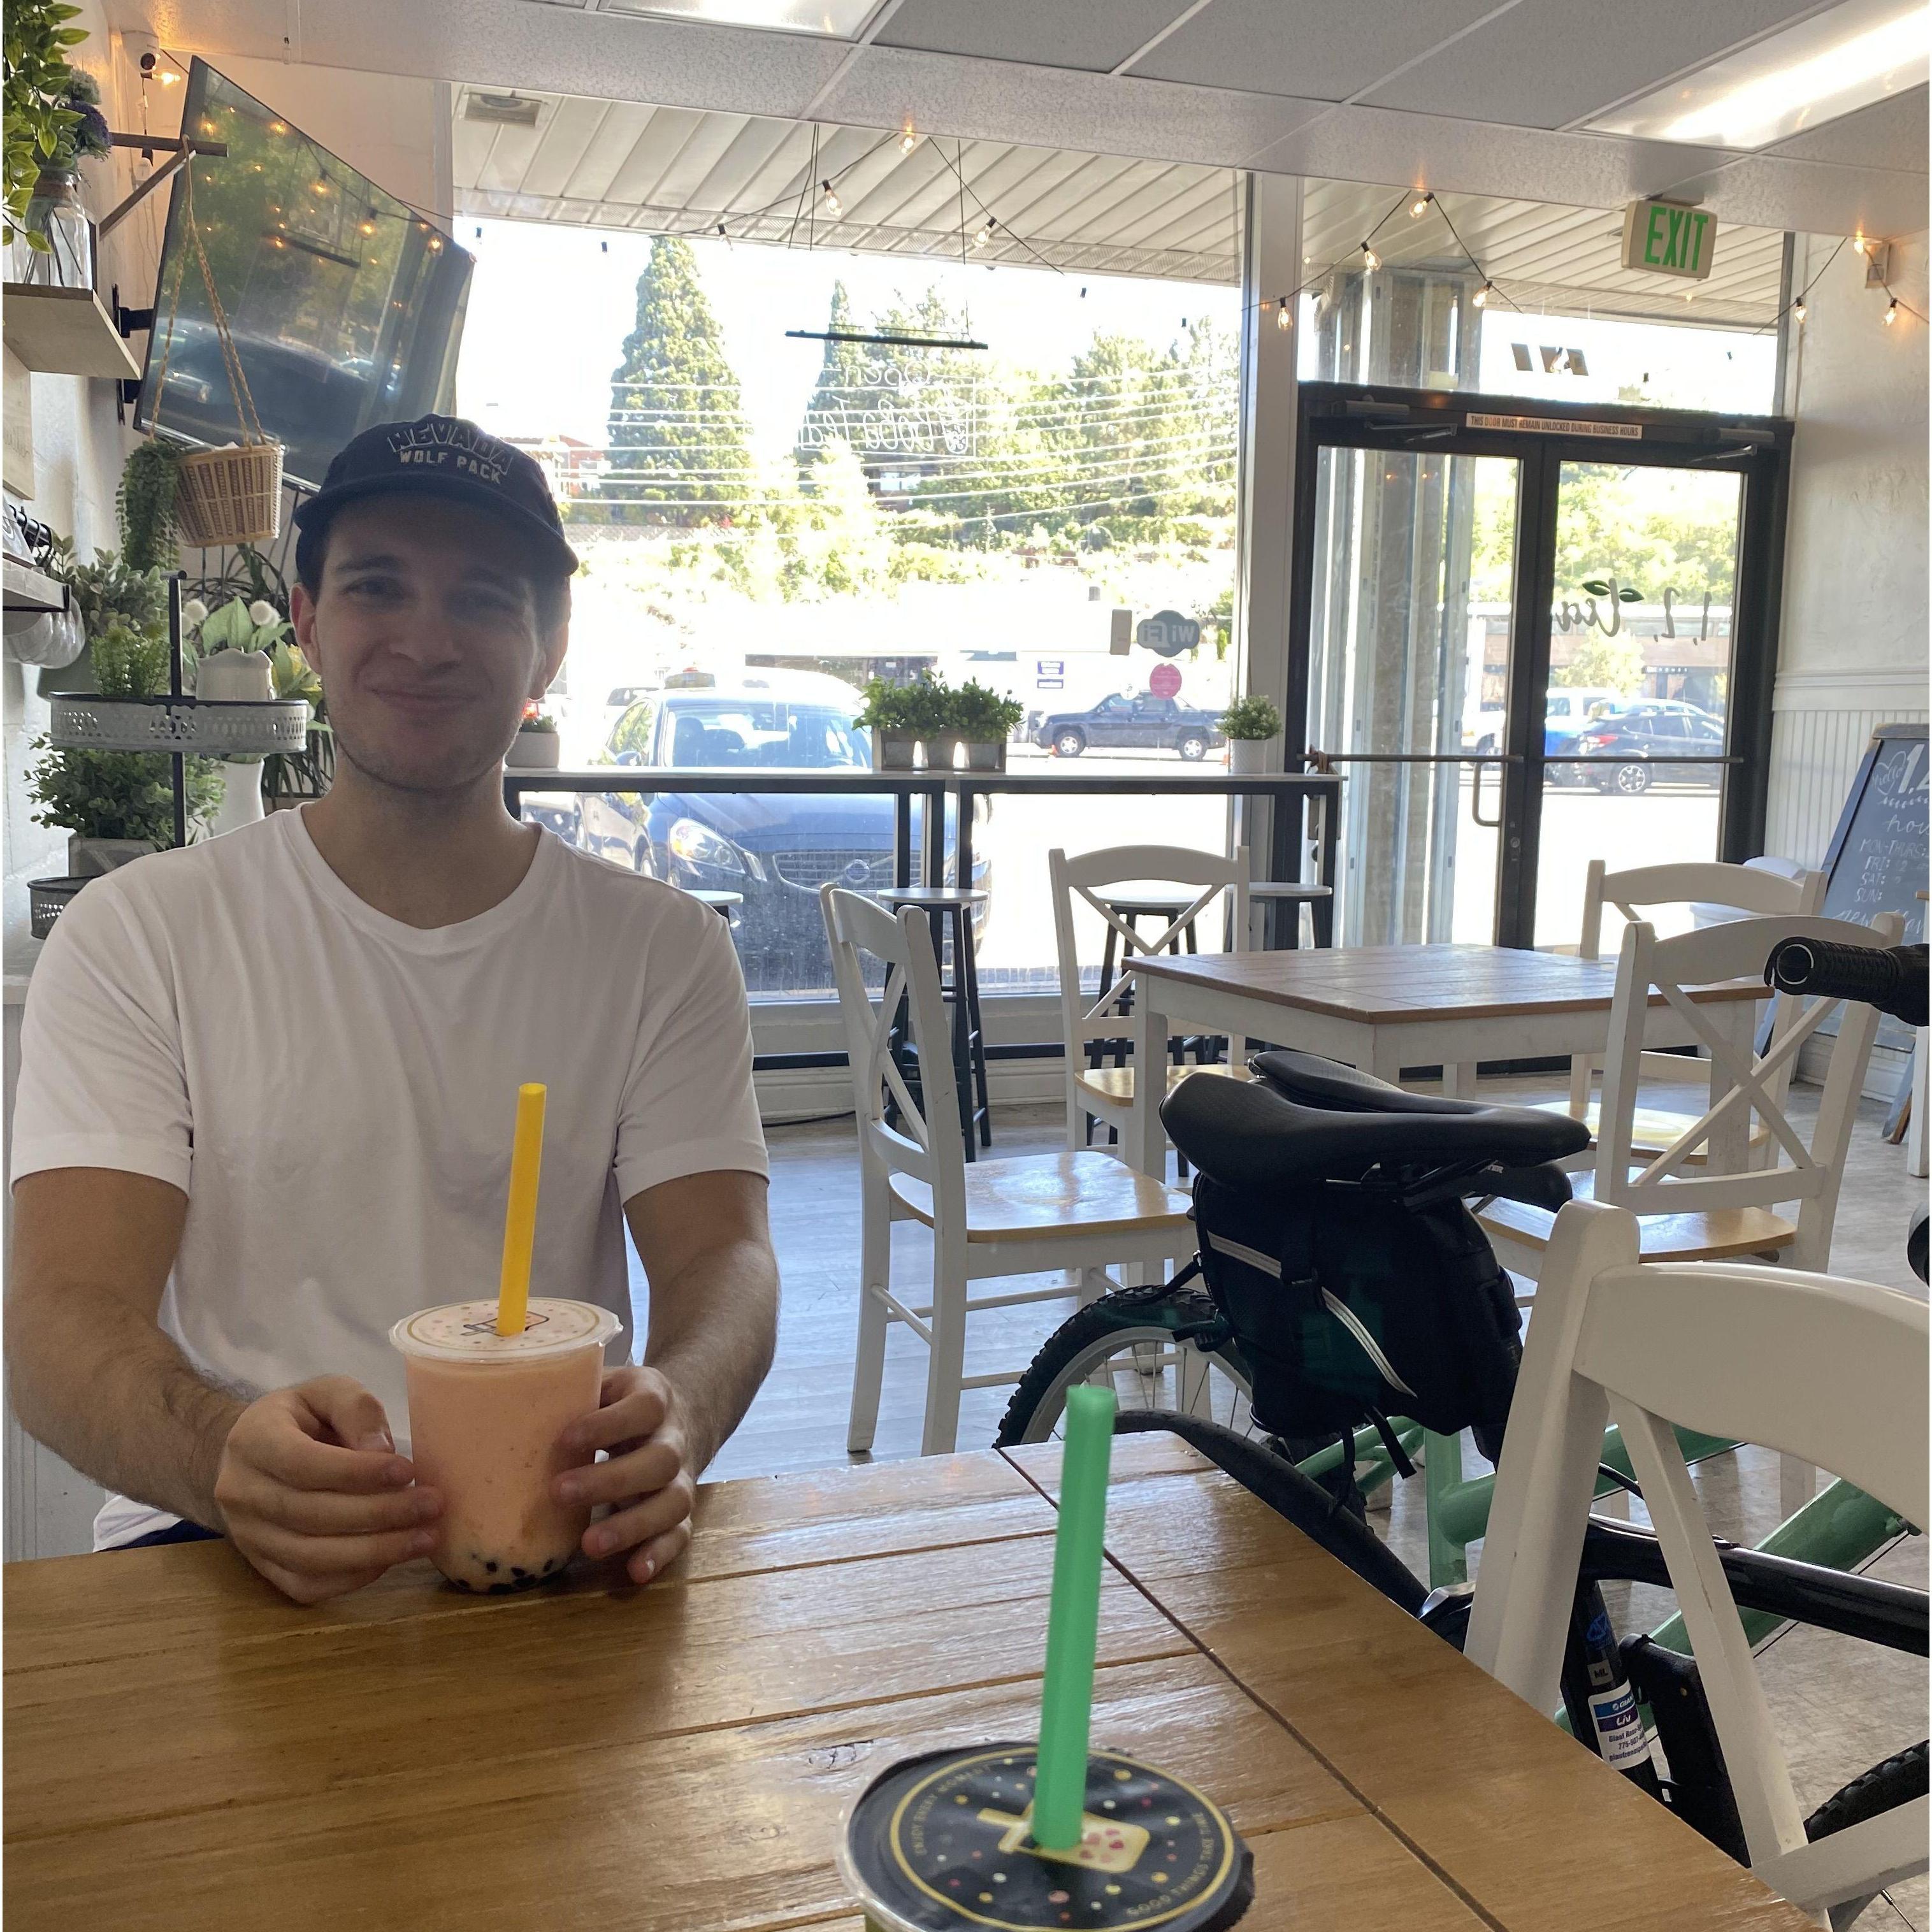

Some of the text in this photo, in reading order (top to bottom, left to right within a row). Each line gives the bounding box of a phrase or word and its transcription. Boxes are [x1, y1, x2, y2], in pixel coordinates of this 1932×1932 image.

[1644, 206, 1709, 271] EXIT
[1471, 415, 1638, 436] THIS DOOR MUST REMAIN UNLOCKED DURING BUSINESS HOURS
[387, 423, 513, 475] NEVADA
[400, 451, 501, 484] WOLF PACK
[1855, 887, 1883, 903] SUN:
